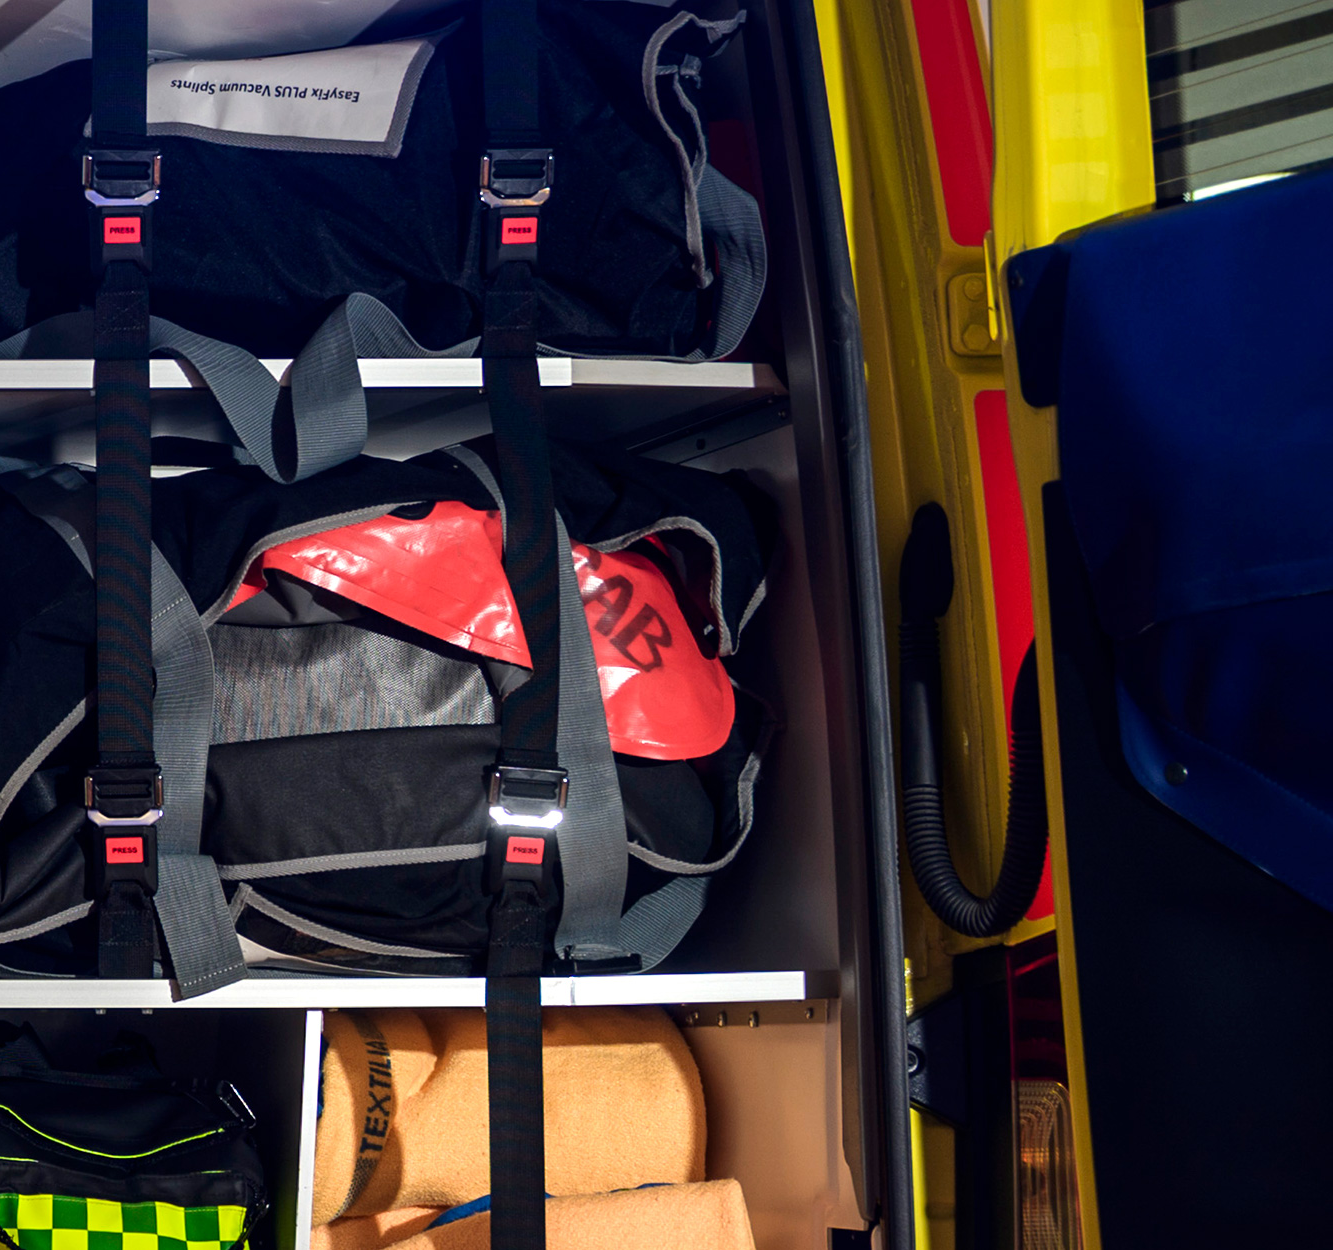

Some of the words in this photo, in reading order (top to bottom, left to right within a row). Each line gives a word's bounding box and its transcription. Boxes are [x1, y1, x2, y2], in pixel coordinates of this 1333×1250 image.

[170, 79, 216, 95] Splints
[219, 82, 271, 97] Vacuum
[274, 85, 308, 99] PLUS
[311, 87, 360, 103] EasyFix
[512, 846, 538, 855] PRESS
[359, 1040, 392, 1153] TEXTILIA
